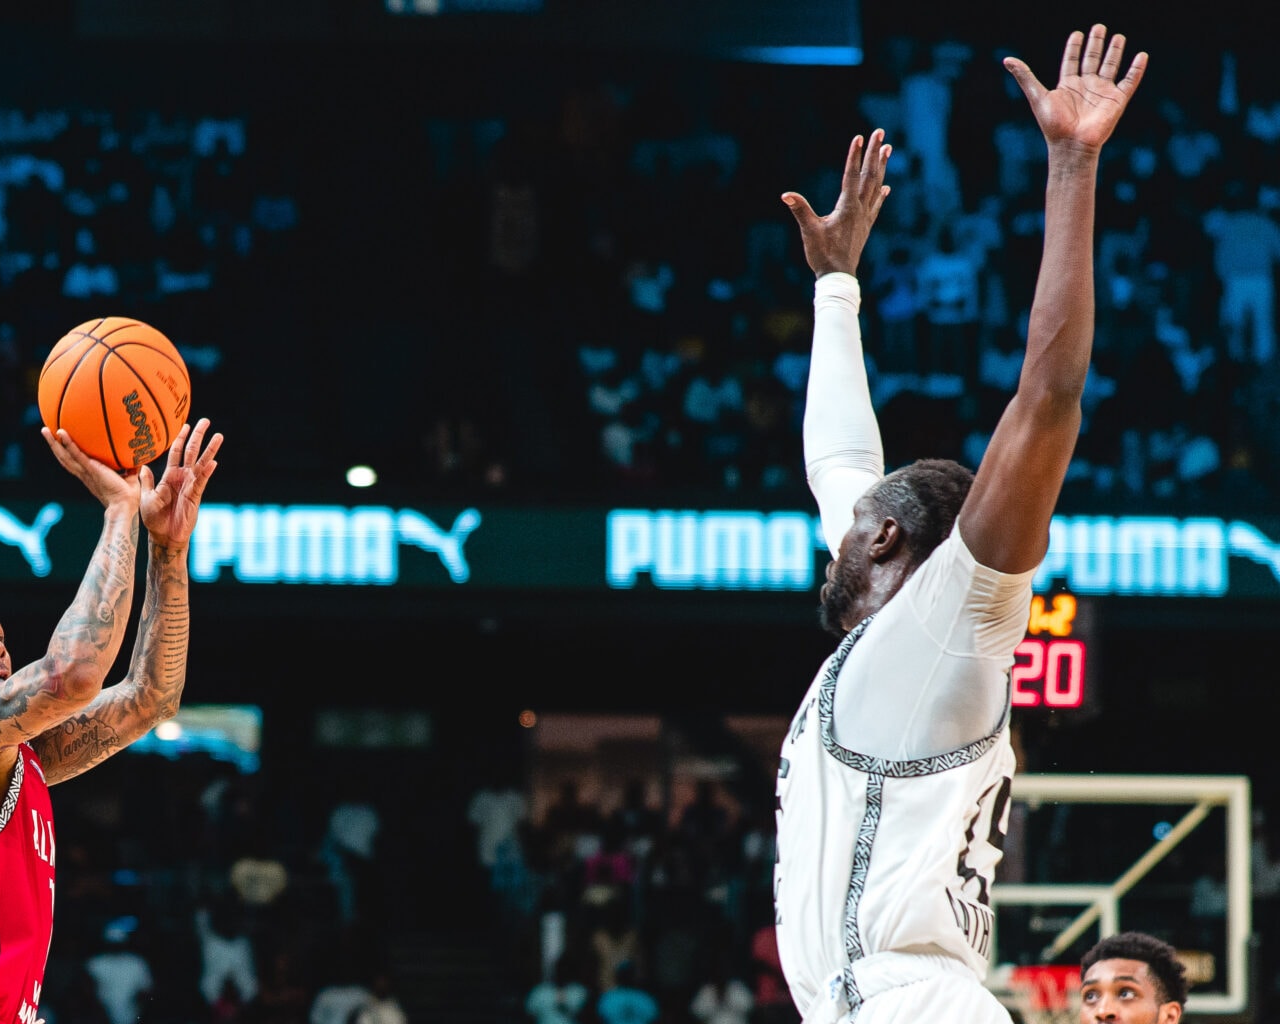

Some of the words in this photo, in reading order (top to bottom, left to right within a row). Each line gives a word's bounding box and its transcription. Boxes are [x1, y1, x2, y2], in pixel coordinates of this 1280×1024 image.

[192, 503, 398, 586] PUMA
[605, 509, 814, 591] PUMA
[1032, 514, 1228, 597] PUMA
[1011, 639, 1086, 707] 20
